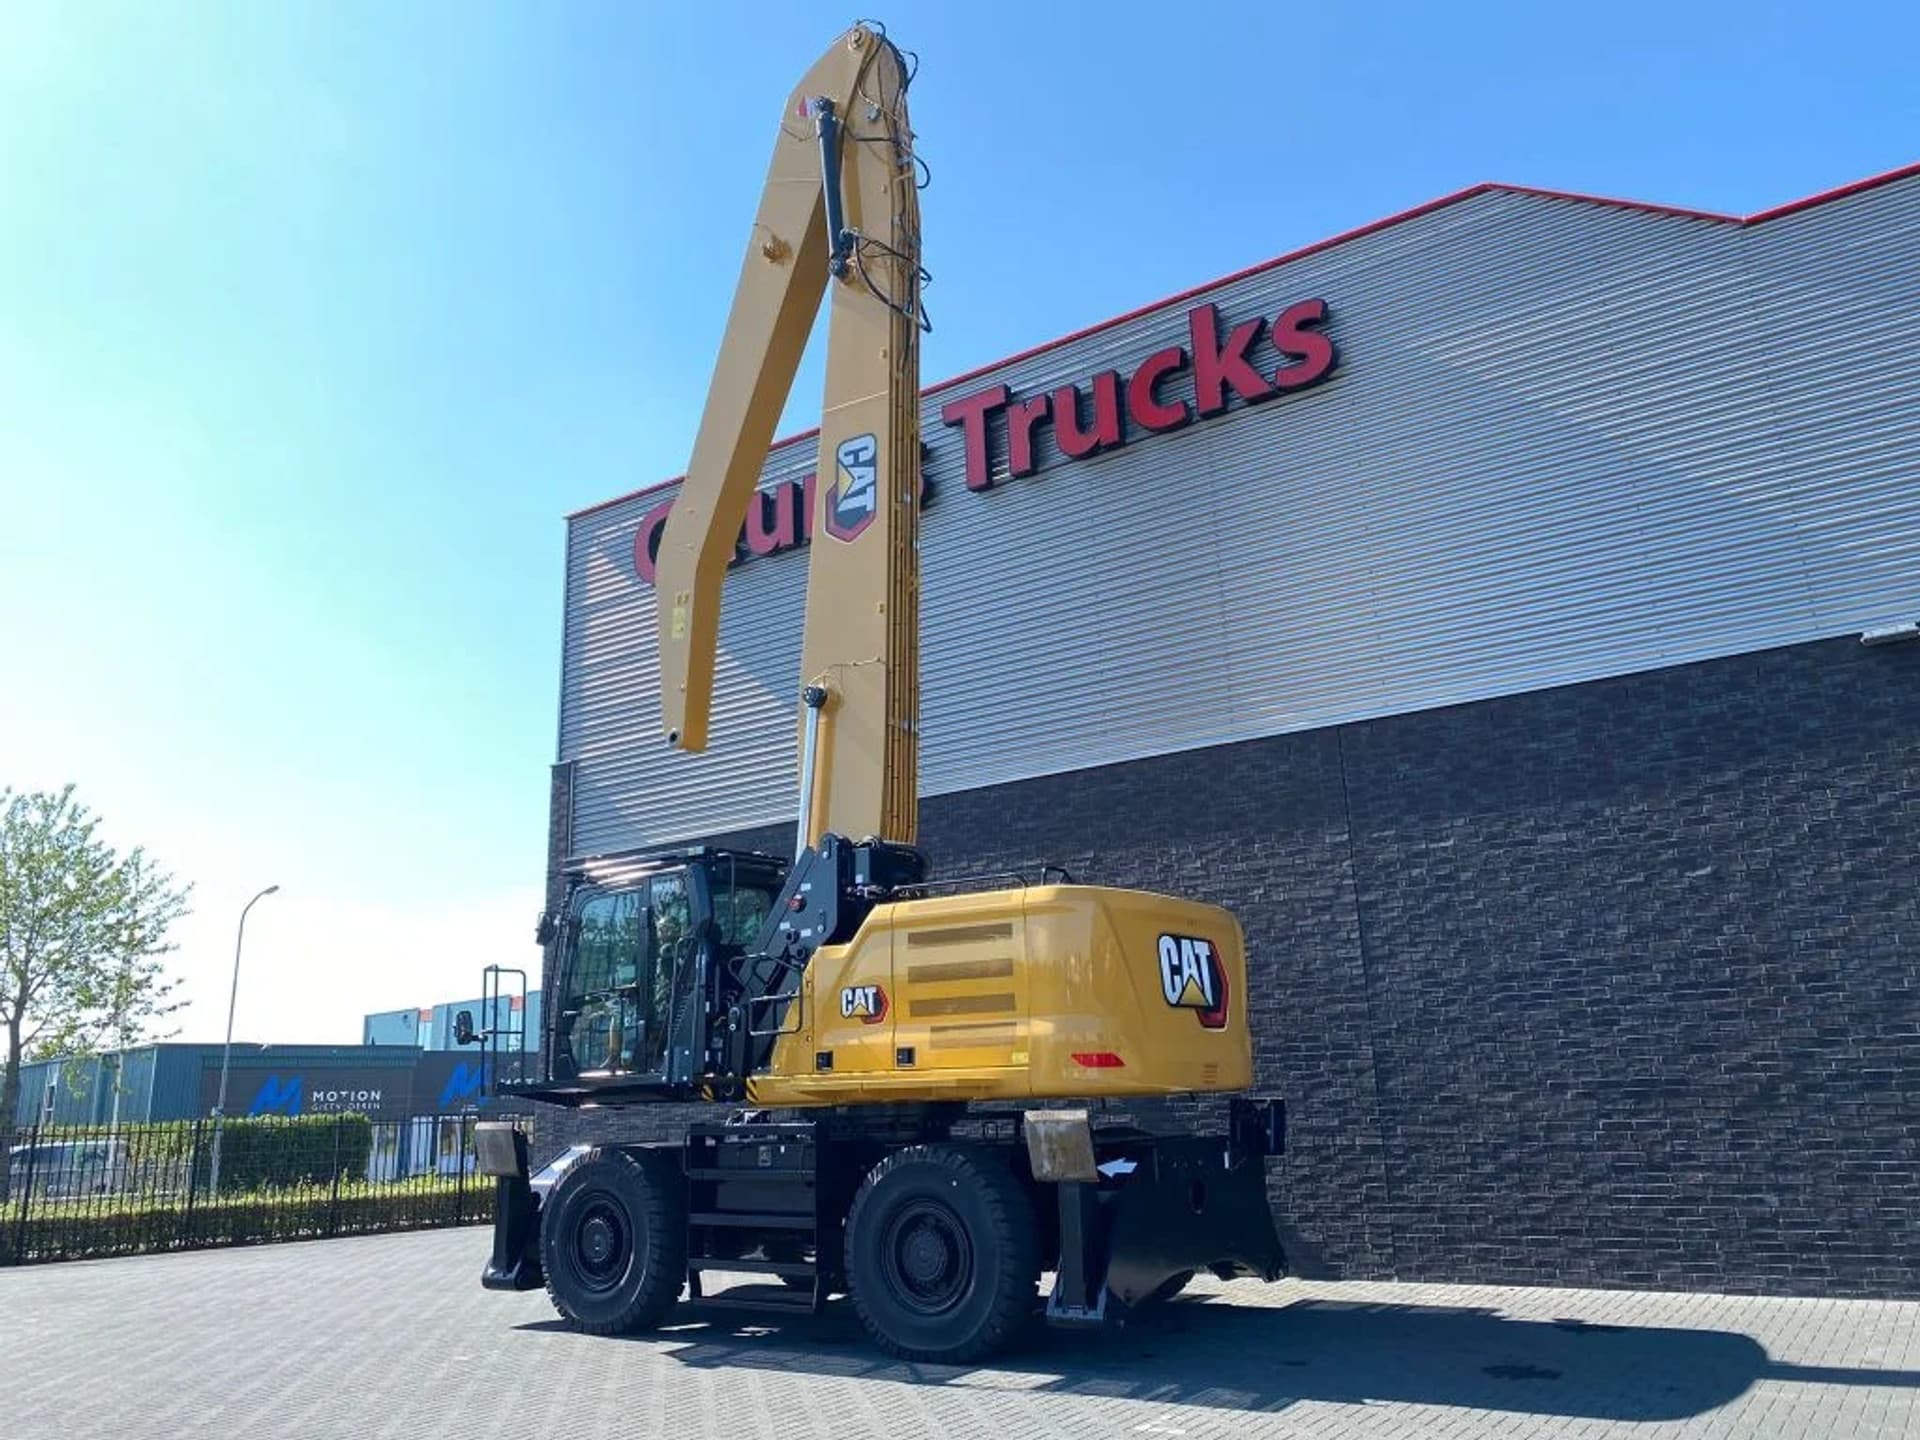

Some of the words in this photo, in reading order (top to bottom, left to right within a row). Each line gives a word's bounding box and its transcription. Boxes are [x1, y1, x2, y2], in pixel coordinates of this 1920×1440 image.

[942, 299, 1336, 491] Trucks
[838, 434, 876, 512] CAT
[841, 986, 877, 1017] CAT
[1158, 935, 1214, 1006] CAT
[312, 1090, 382, 1102] MOTION
